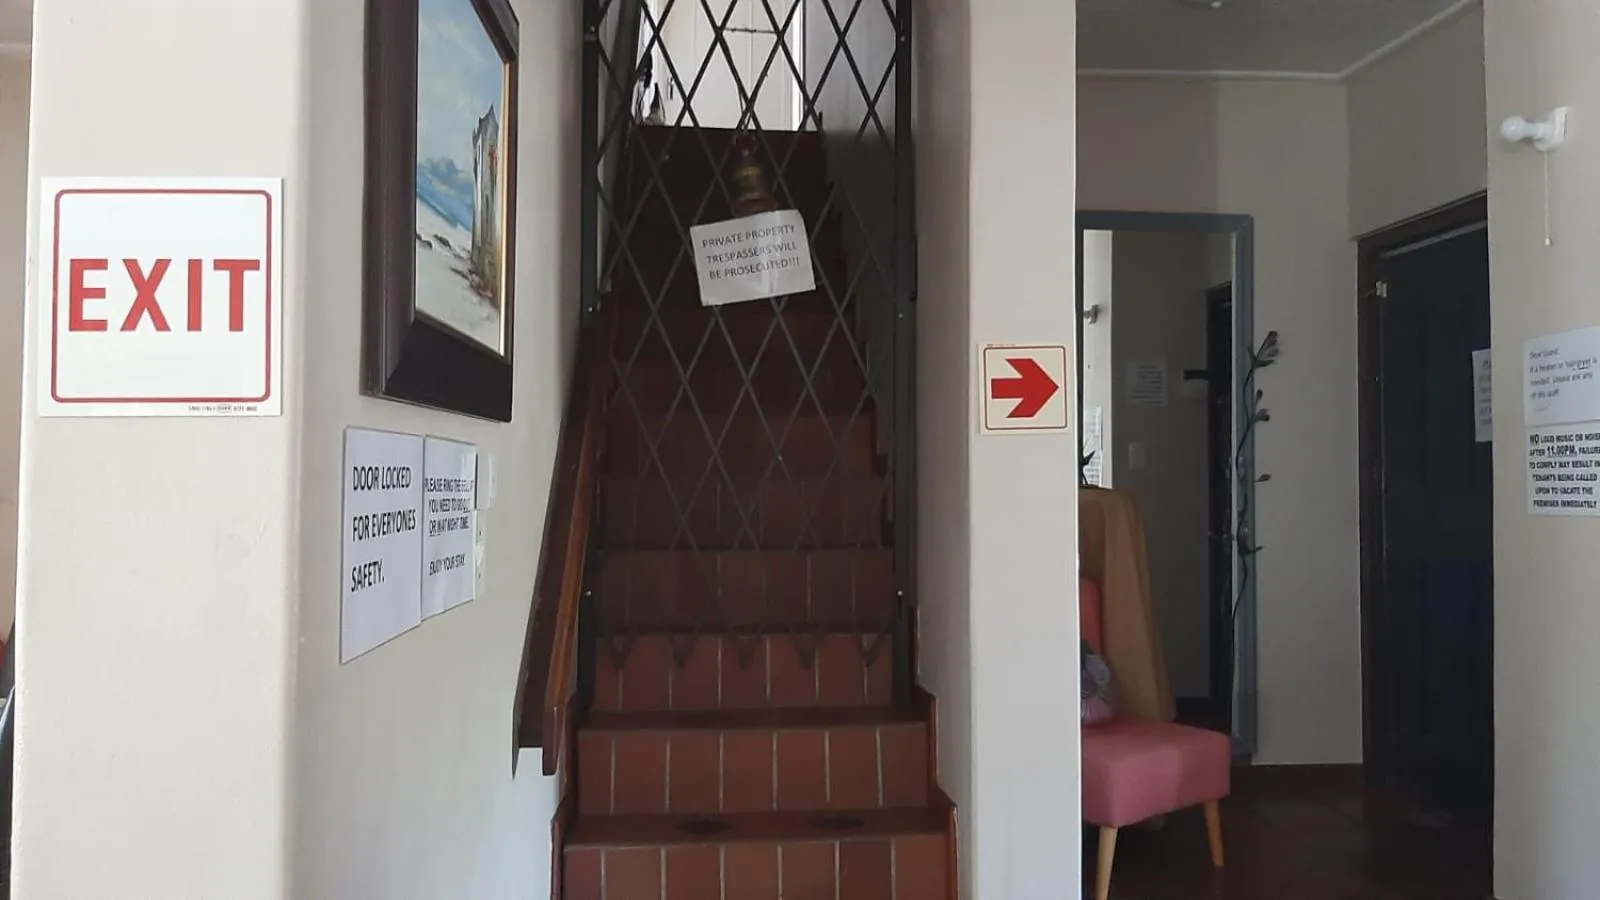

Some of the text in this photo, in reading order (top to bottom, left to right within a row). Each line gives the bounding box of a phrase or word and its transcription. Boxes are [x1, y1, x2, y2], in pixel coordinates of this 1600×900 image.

[702, 224, 795, 248] PRIVATE PROPERTY
[706, 240, 798, 264] TRESPASSERS WILL
[709, 256, 800, 280] BE PROSECUTED!!!
[68, 258, 261, 332] EXIT
[1530, 434, 1539, 444] NO
[1541, 435, 1554, 443] LOUD
[1556, 434, 1574, 442] MUSIC
[1575, 433, 1583, 441] OR
[1537, 461, 1557, 469] COMPLY
[1572, 460, 1593, 468] RESULT
[353, 464, 412, 491] DOOR LOCKED
[424, 478, 443, 492] PLEASE
[443, 478, 454, 492] RING
[1576, 473, 1597, 481] CALLED
[1535, 487, 1550, 495] UPON
[429, 498, 439, 513] YOU
[440, 498, 450, 512] NEED
[1561, 500, 1597, 508] IMMEDIATELY
[353, 508, 416, 541] FOR EVERYONES
[429, 520, 437, 534] OR
[429, 559, 442, 576] ENJOY
[443, 556, 455, 571] YOUR
[351, 559, 385, 592] SAFETY.
